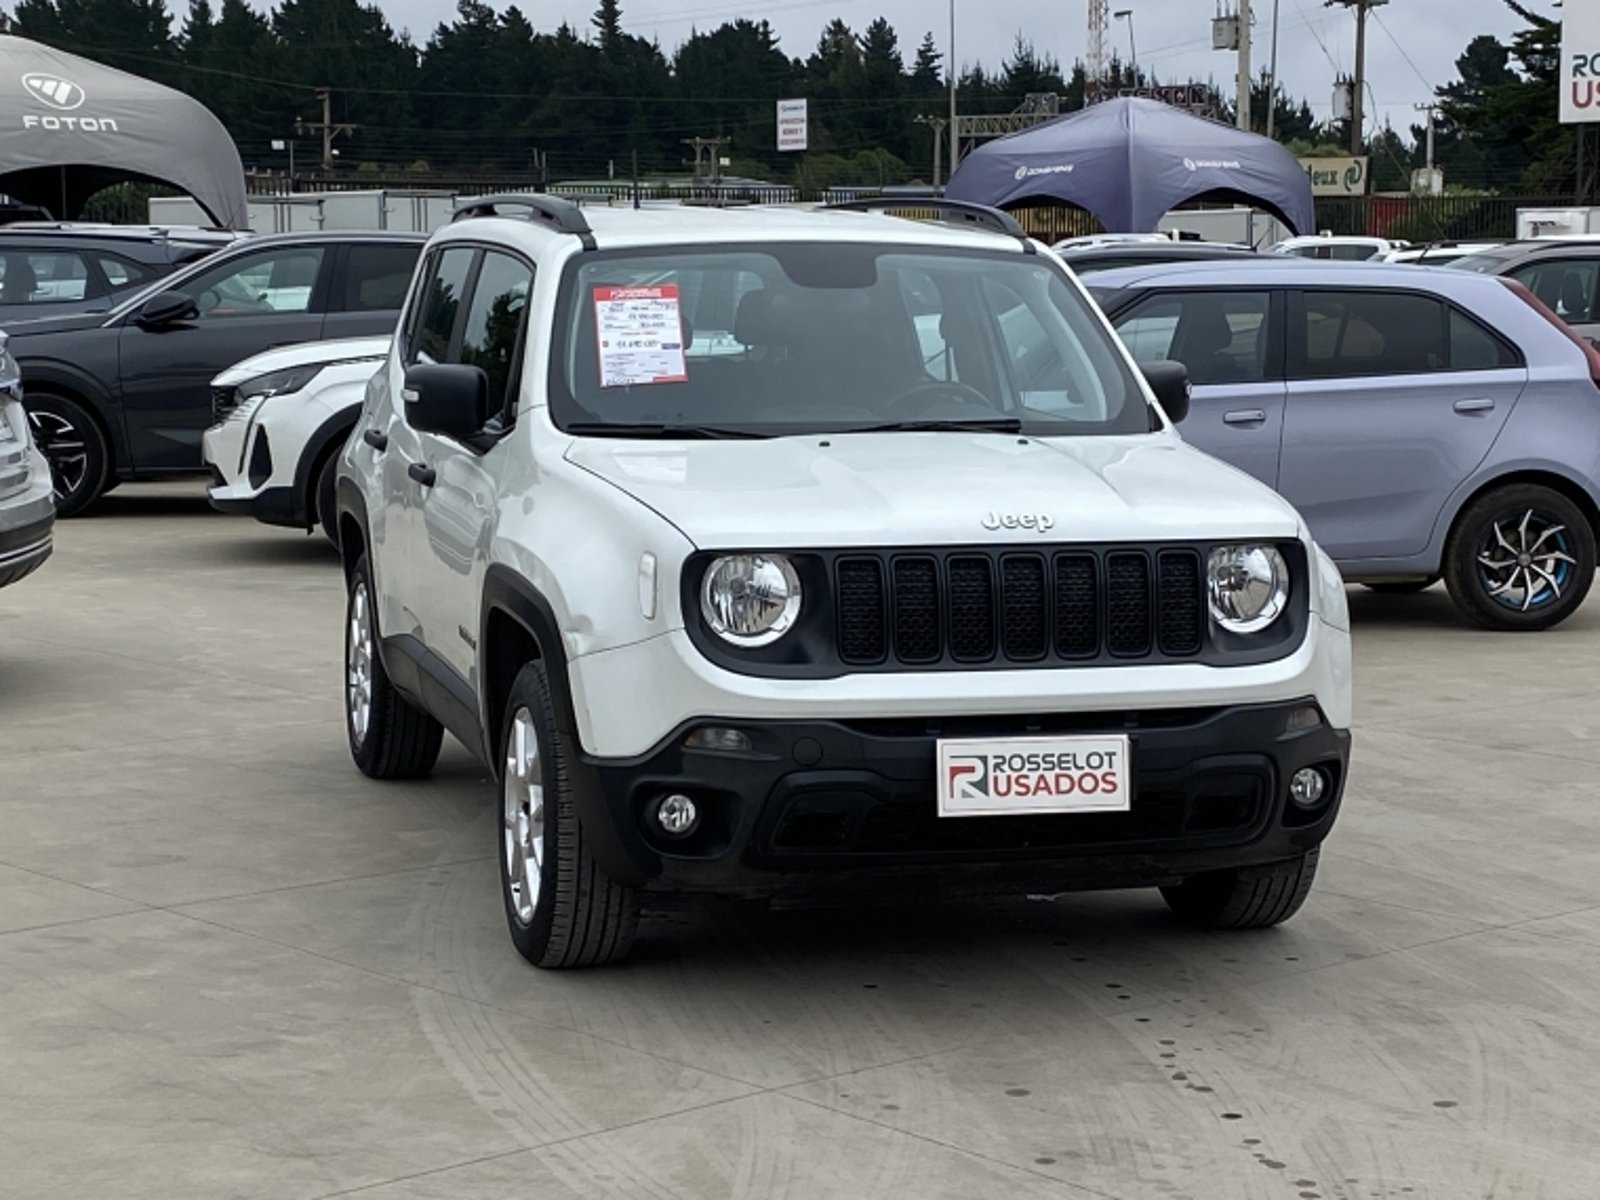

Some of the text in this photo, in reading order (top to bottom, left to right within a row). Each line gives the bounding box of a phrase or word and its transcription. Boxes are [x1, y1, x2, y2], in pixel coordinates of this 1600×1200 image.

[1572, 81, 1600, 109] U
[22, 115, 118, 131] FOTON
[980, 511, 1054, 533] Jeep
[993, 752, 1117, 773] ROSSELOT
[993, 771, 1118, 797] USADOS
